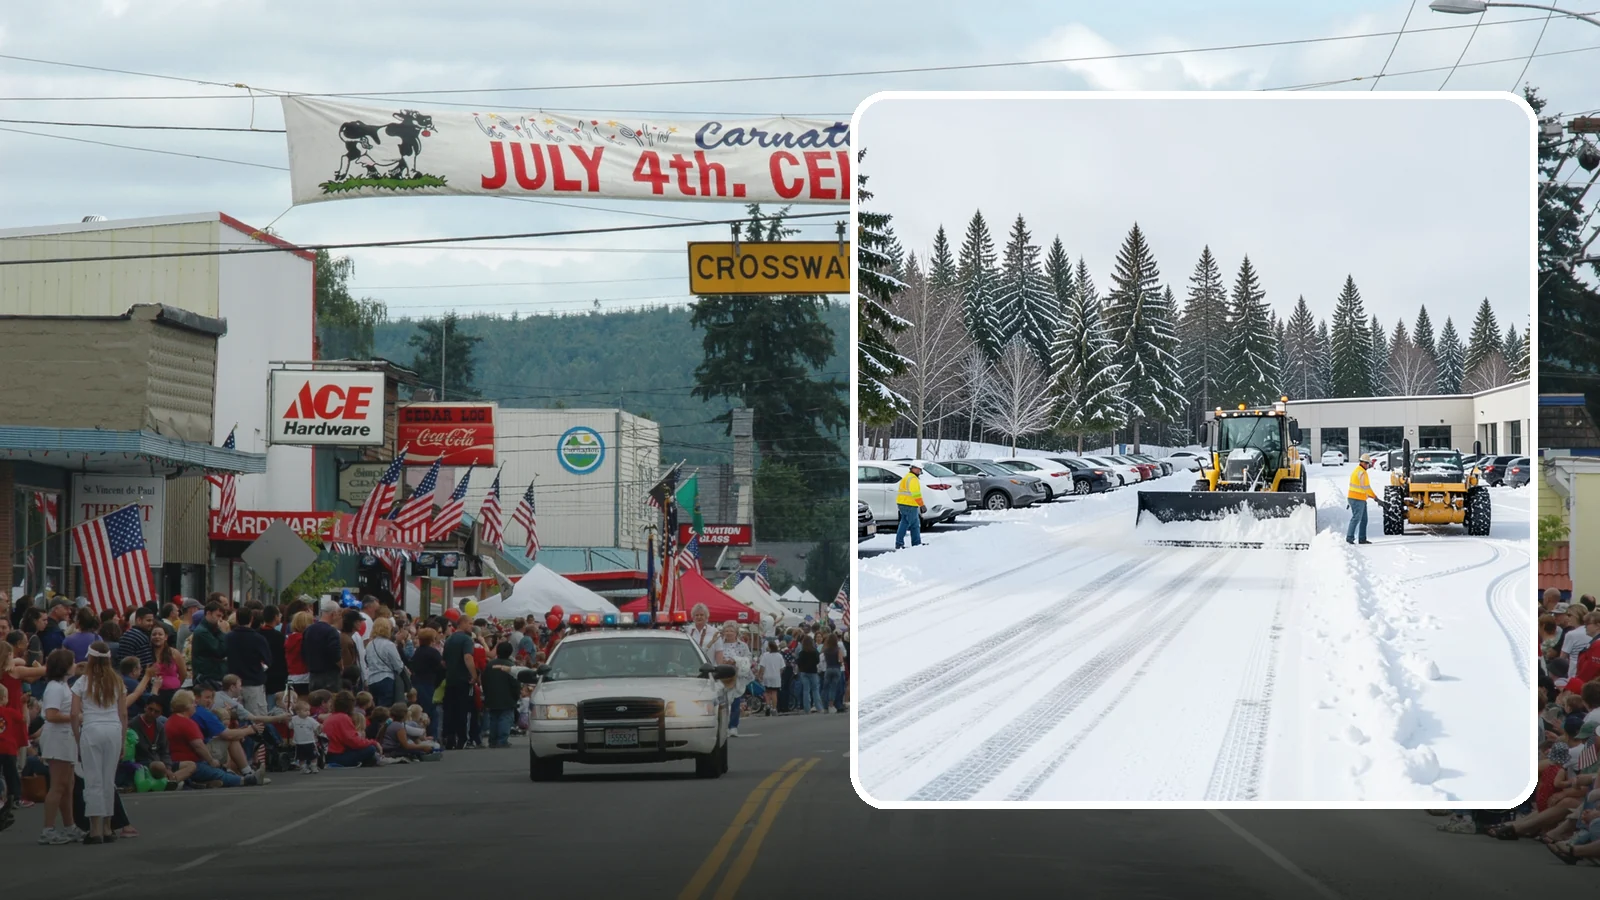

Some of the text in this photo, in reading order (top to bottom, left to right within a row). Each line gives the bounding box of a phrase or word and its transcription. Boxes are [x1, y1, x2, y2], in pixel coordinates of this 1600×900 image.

[481, 141, 604, 192] JULY
[632, 150, 746, 198] 4th.
[697, 254, 850, 280] CROSSWA
[282, 380, 374, 420] ACE
[406, 409, 453, 422] CEDAR
[283, 421, 371, 437] Hardware
[96, 485, 124, 494] Vincent
[126, 486, 136, 494] de
[137, 486, 155, 495] Paul
[688, 526, 742, 535] CRNATION
[699, 535, 730, 544] GLASS
